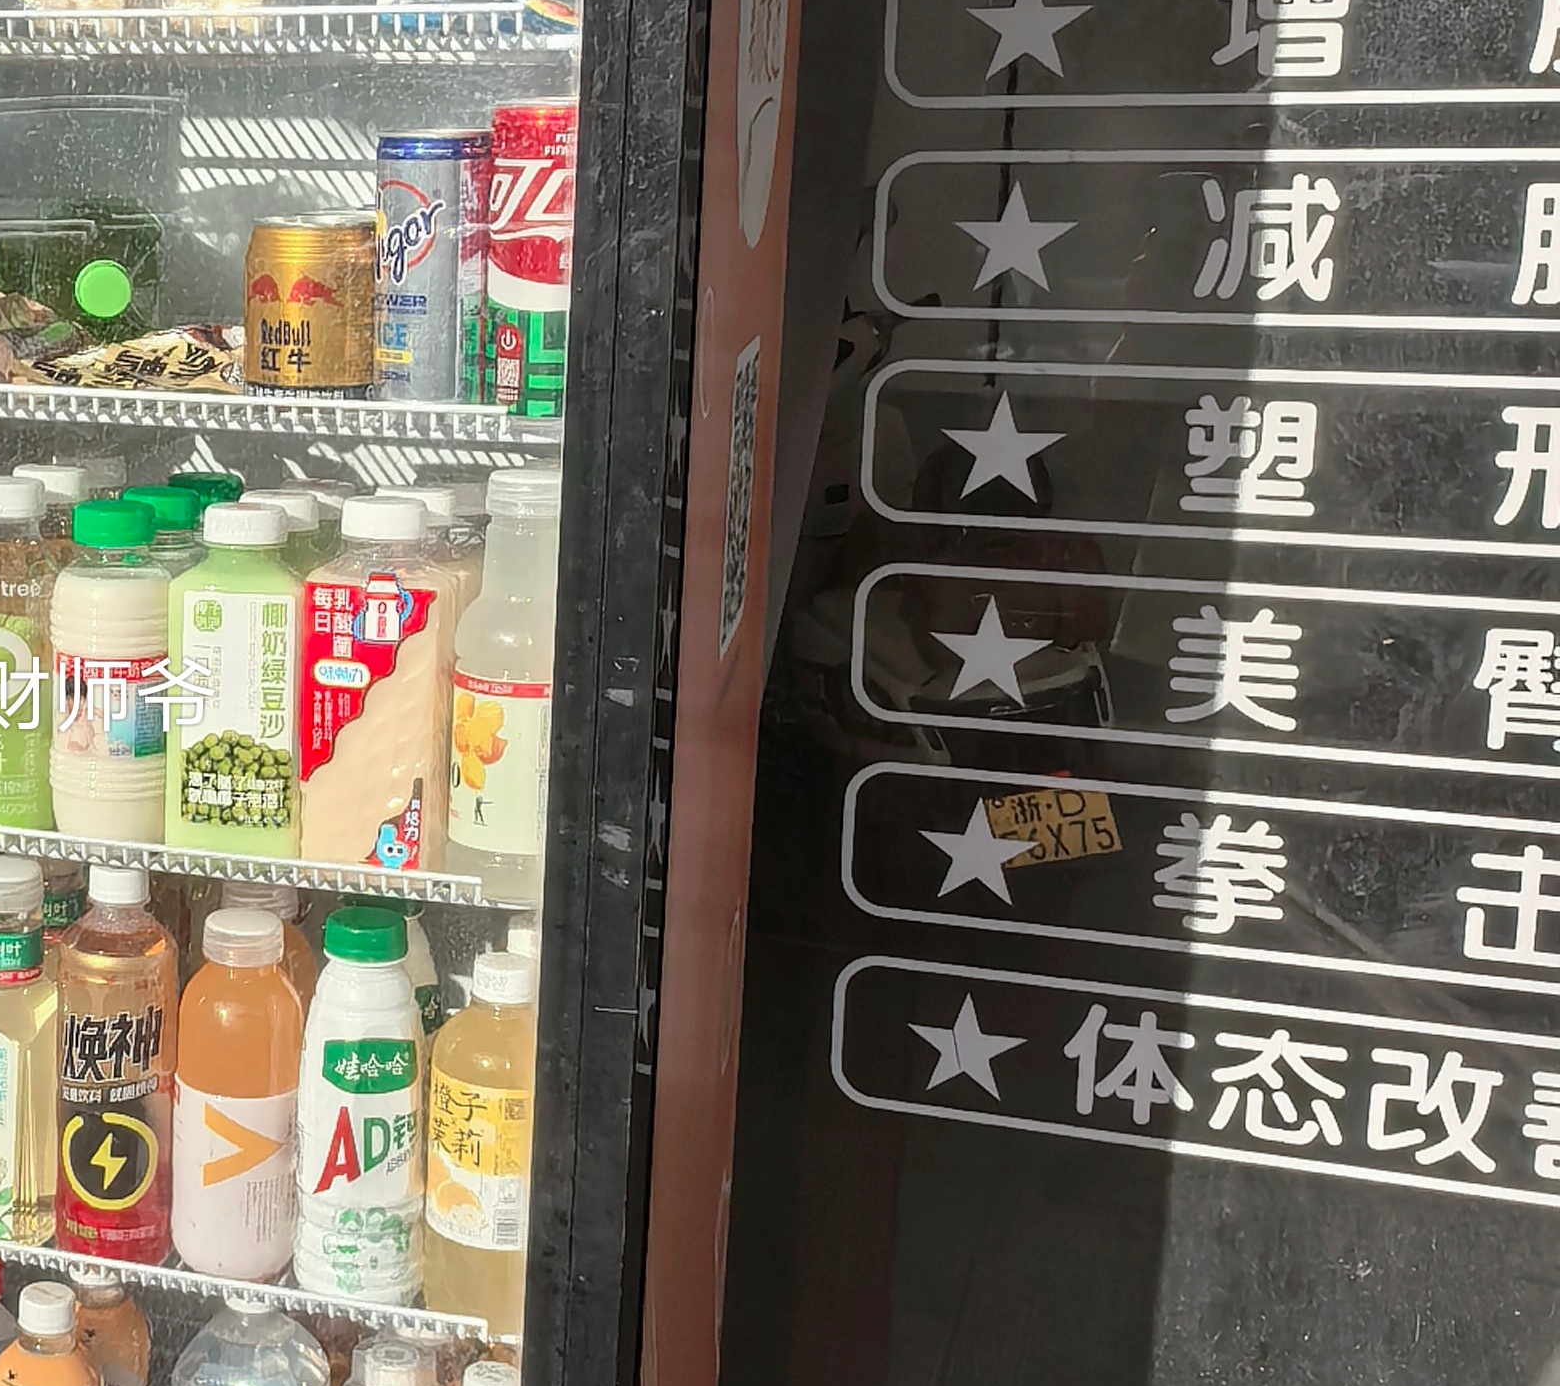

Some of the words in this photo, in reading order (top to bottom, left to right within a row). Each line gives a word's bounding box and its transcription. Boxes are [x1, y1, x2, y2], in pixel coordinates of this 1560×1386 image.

[261, 349, 311, 373] 红牛
[314, 587, 333, 633] 每日
[261, 602, 287, 738] 椰奶绿豆沙
[62, 1002, 163, 1084] 焕神
[335, 1051, 408, 1082] 娃哈哈
[434, 1082, 487, 1122] 橙子
